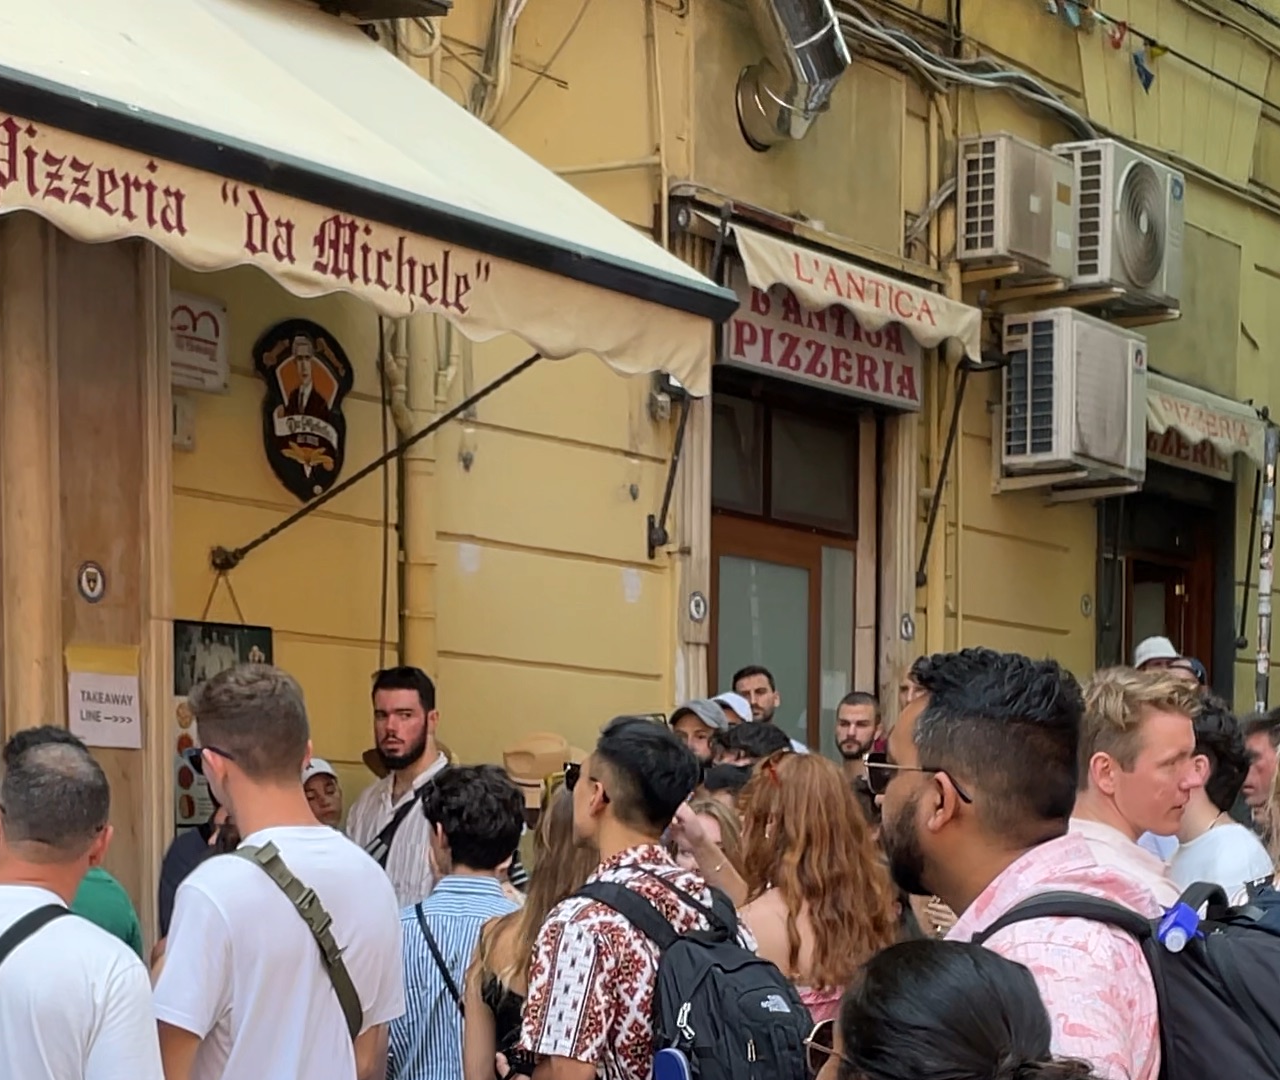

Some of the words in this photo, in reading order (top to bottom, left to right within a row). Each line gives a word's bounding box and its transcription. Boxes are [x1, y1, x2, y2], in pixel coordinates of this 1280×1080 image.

[793, 251, 937, 327] L'ANTICA
[733, 318, 919, 402] PIZZERIA
[80, 690, 134, 707] TAKEAWAY
[80, 709, 102, 723] LINE
